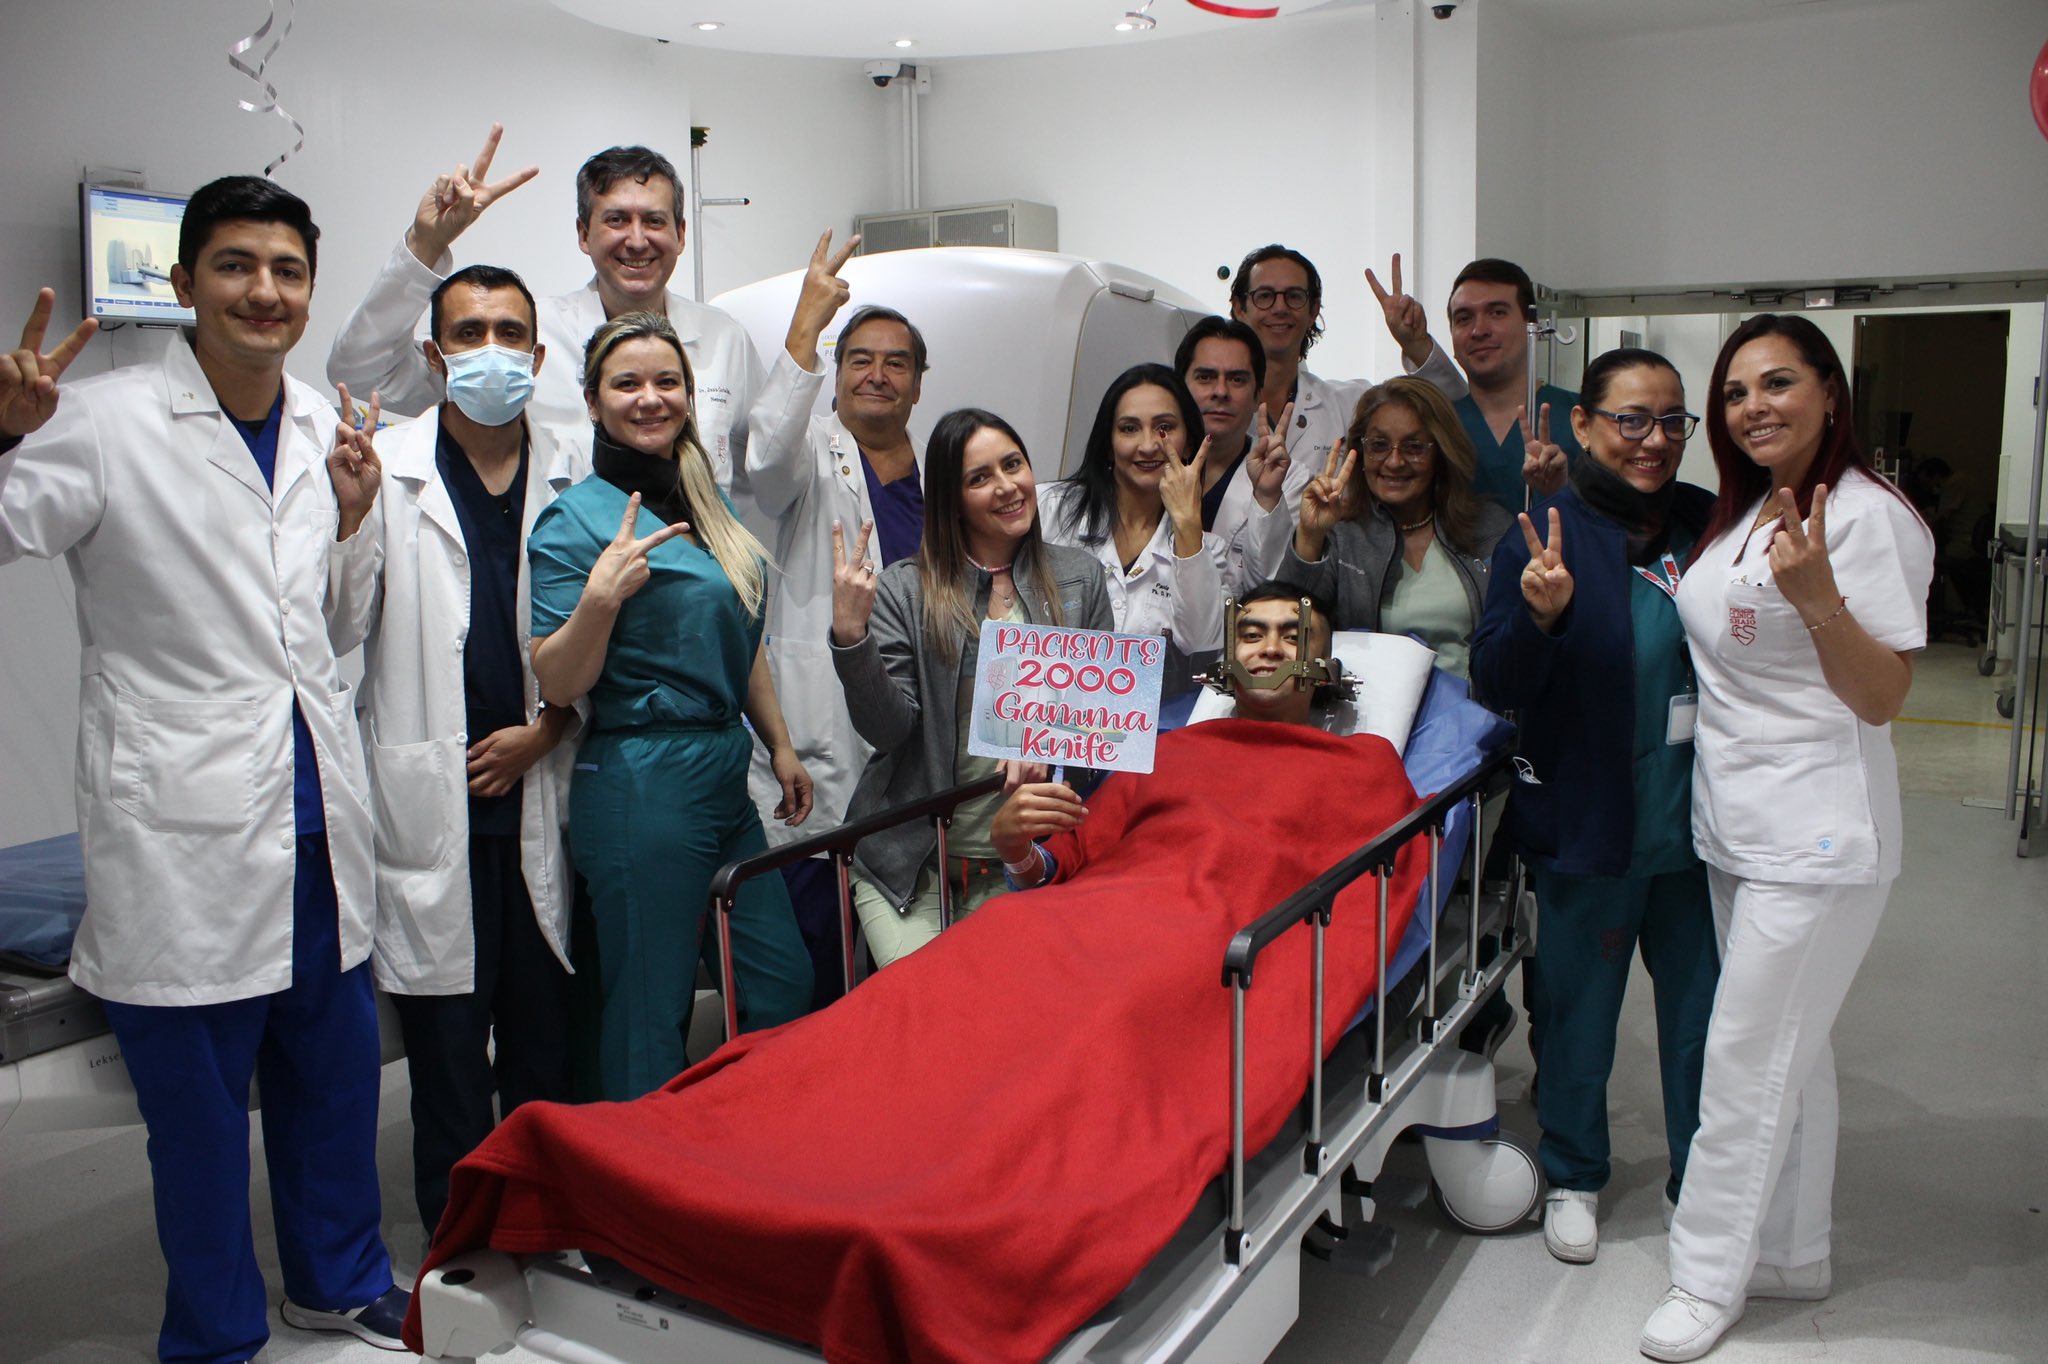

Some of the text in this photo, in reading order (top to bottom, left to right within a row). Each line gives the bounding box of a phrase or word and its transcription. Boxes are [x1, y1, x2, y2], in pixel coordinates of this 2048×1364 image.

[997, 627, 1160, 666] PACIENTE
[1013, 660, 1137, 696] 2000
[993, 691, 1153, 732] Gamma
[1021, 726, 1119, 767] Knife
[90, 1054, 121, 1069] Lekse
